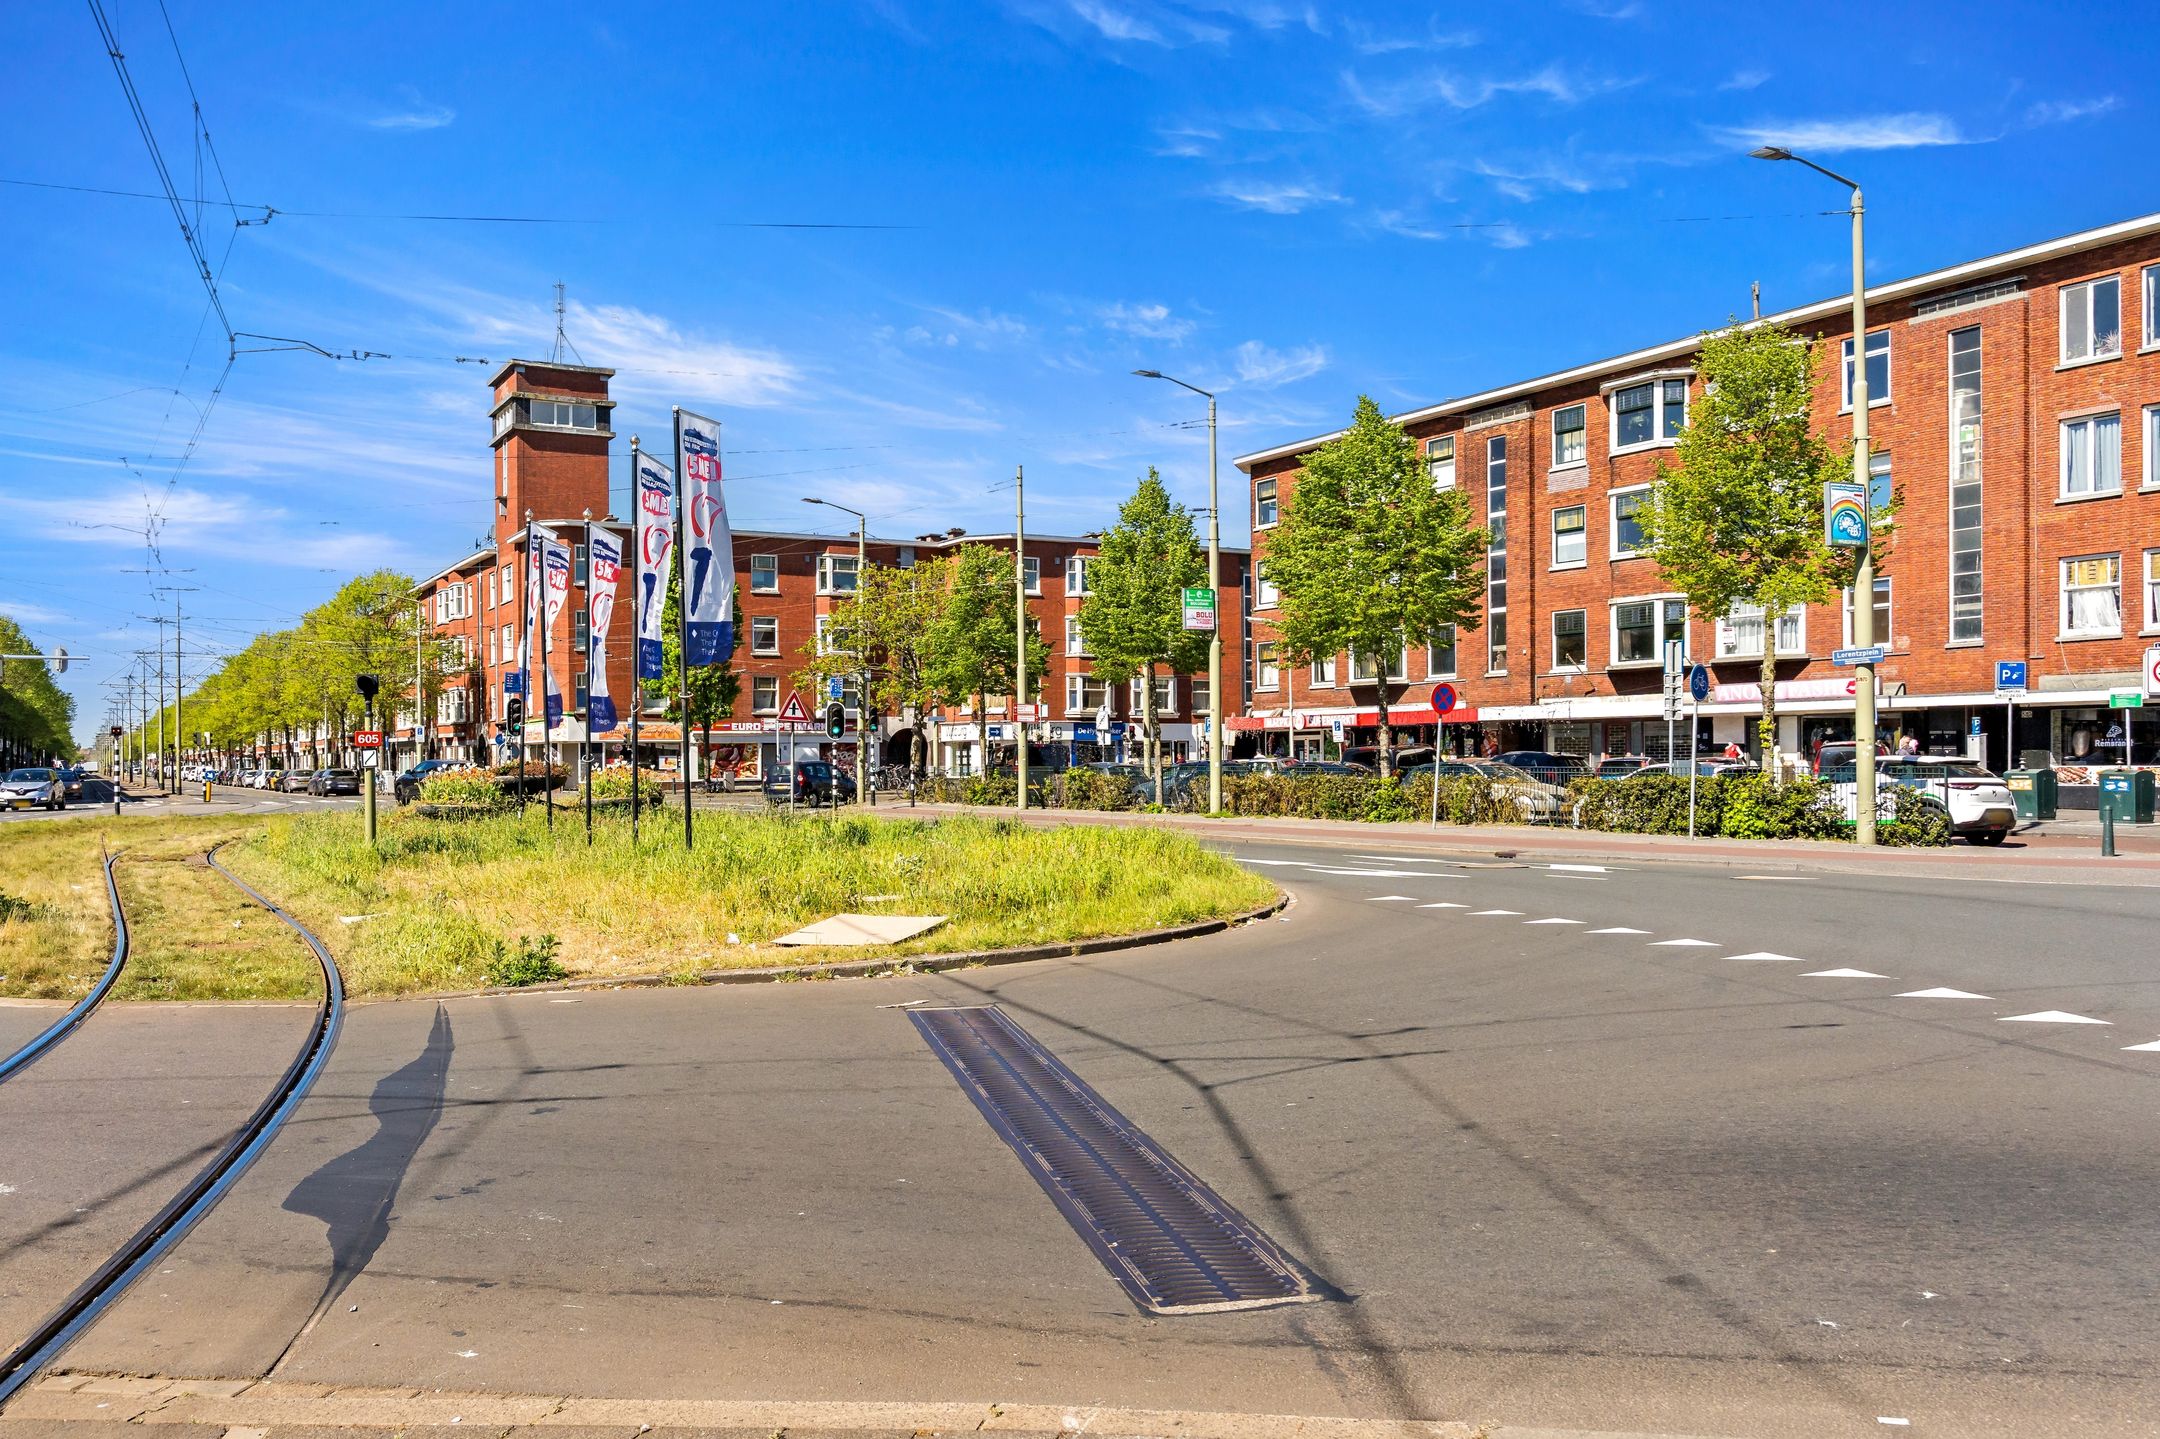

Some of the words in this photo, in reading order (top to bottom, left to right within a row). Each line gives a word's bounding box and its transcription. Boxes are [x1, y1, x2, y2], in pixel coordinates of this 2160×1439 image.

[1837, 650, 1880, 658] Lorentzplein
[2002, 670, 2011, 680] P
[731, 722, 761, 731] EURO
[358, 735, 379, 744] 605
